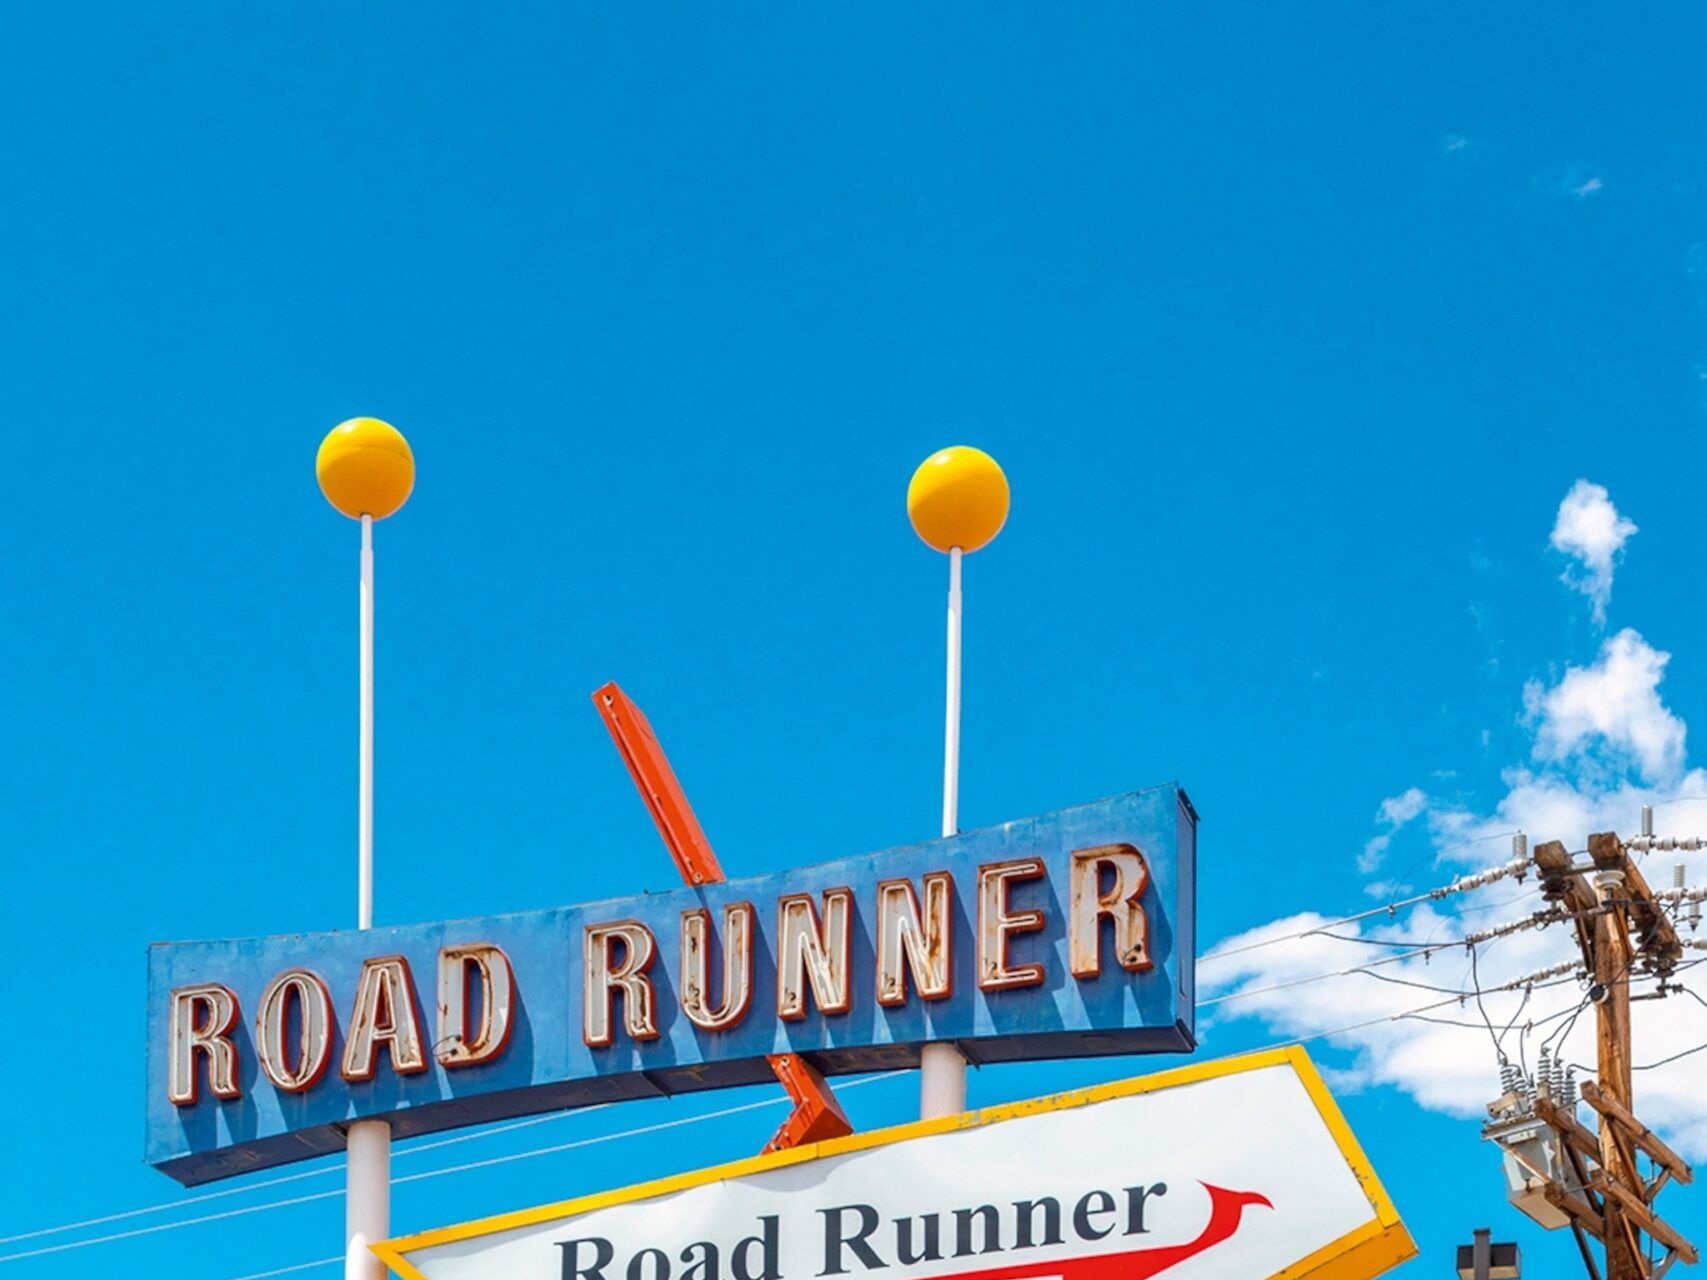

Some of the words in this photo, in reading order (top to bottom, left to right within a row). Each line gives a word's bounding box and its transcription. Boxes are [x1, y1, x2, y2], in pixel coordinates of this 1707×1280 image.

[168, 943, 512, 1105] ROAD
[583, 843, 1154, 1048] RUNNER
[815, 1181, 1167, 1276] Runner
